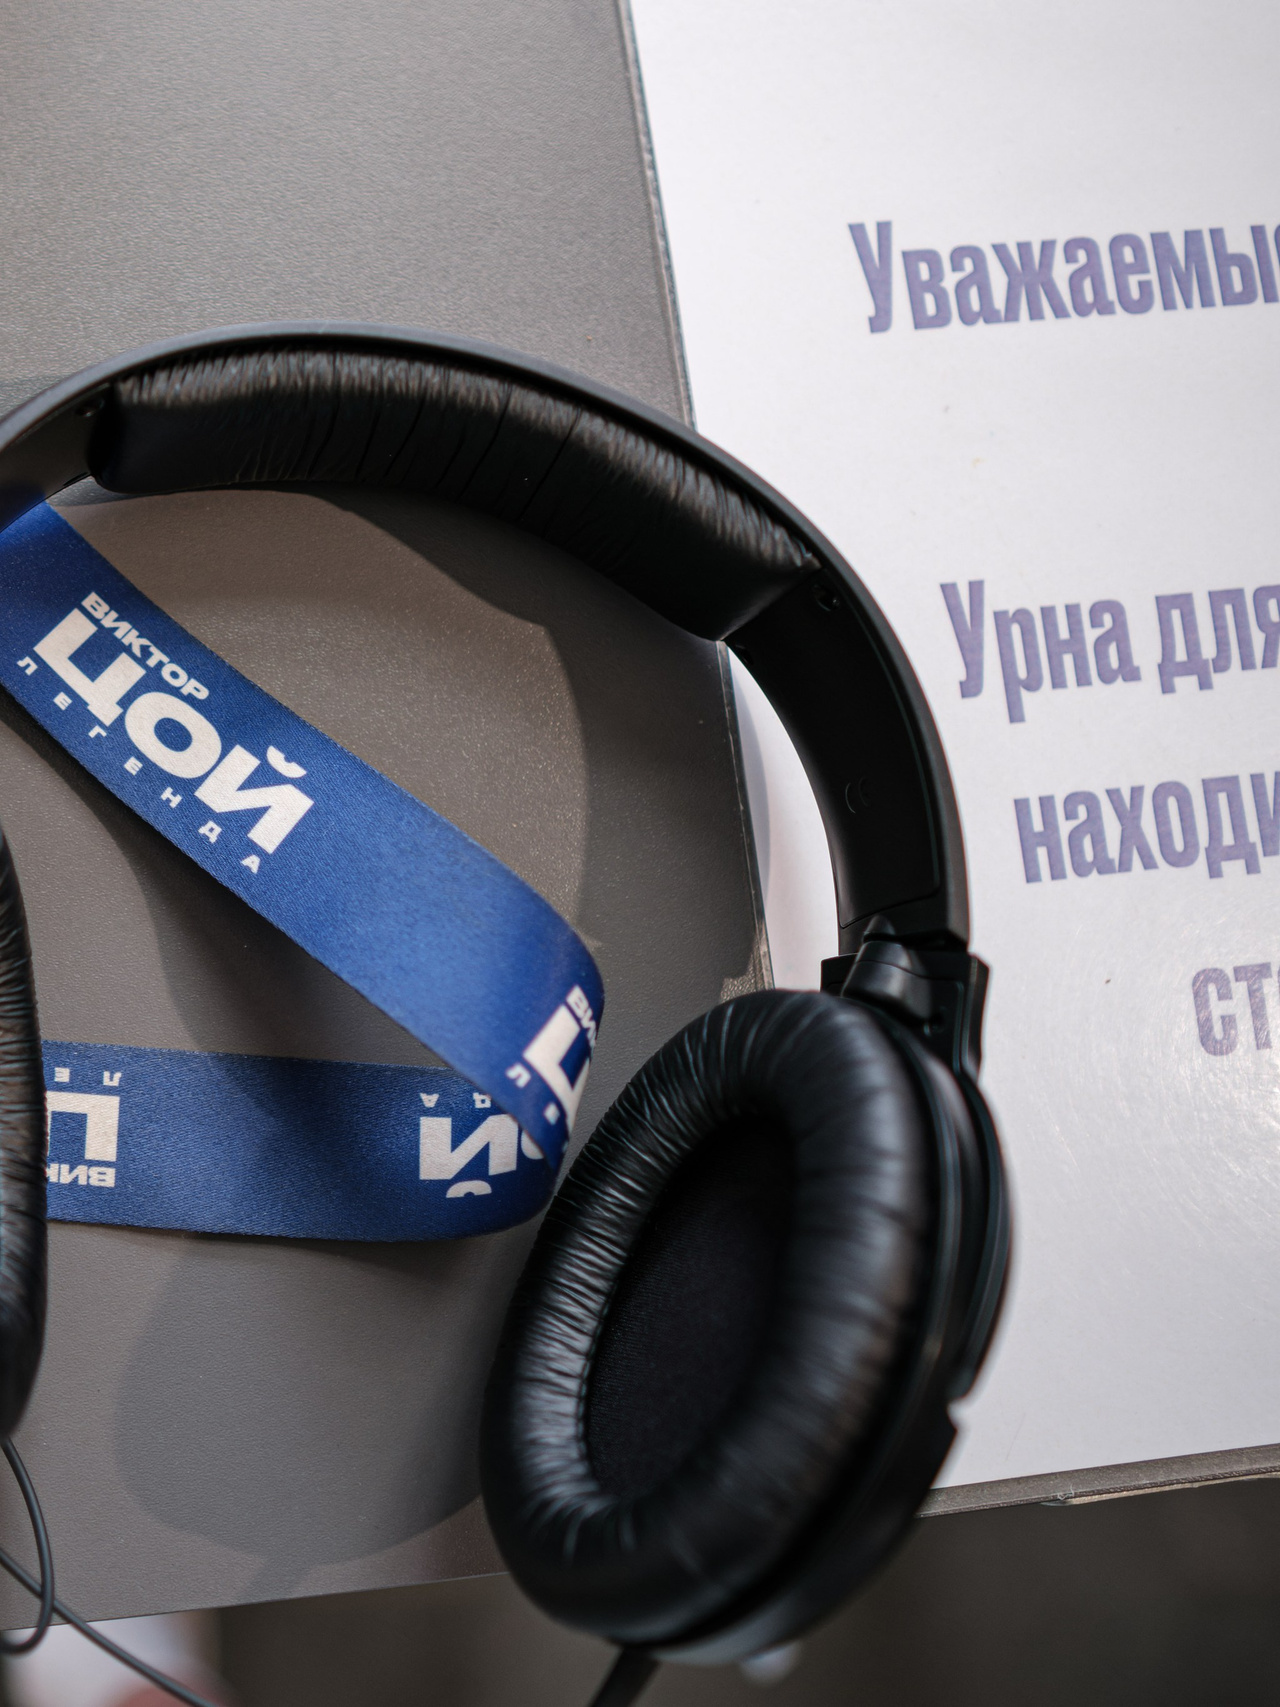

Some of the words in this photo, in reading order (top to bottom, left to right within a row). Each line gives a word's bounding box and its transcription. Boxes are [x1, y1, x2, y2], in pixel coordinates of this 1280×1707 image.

[848, 221, 1280, 334] Уважаемы
[81, 591, 210, 700] ВИКТОР
[939, 579, 1142, 724] Урна
[1155, 584, 1280, 694] для
[17, 656, 261, 874] ЛЕГЕНДА
[33, 607, 315, 855] ЦОЙ
[1192, 962, 1280, 1057] ст
